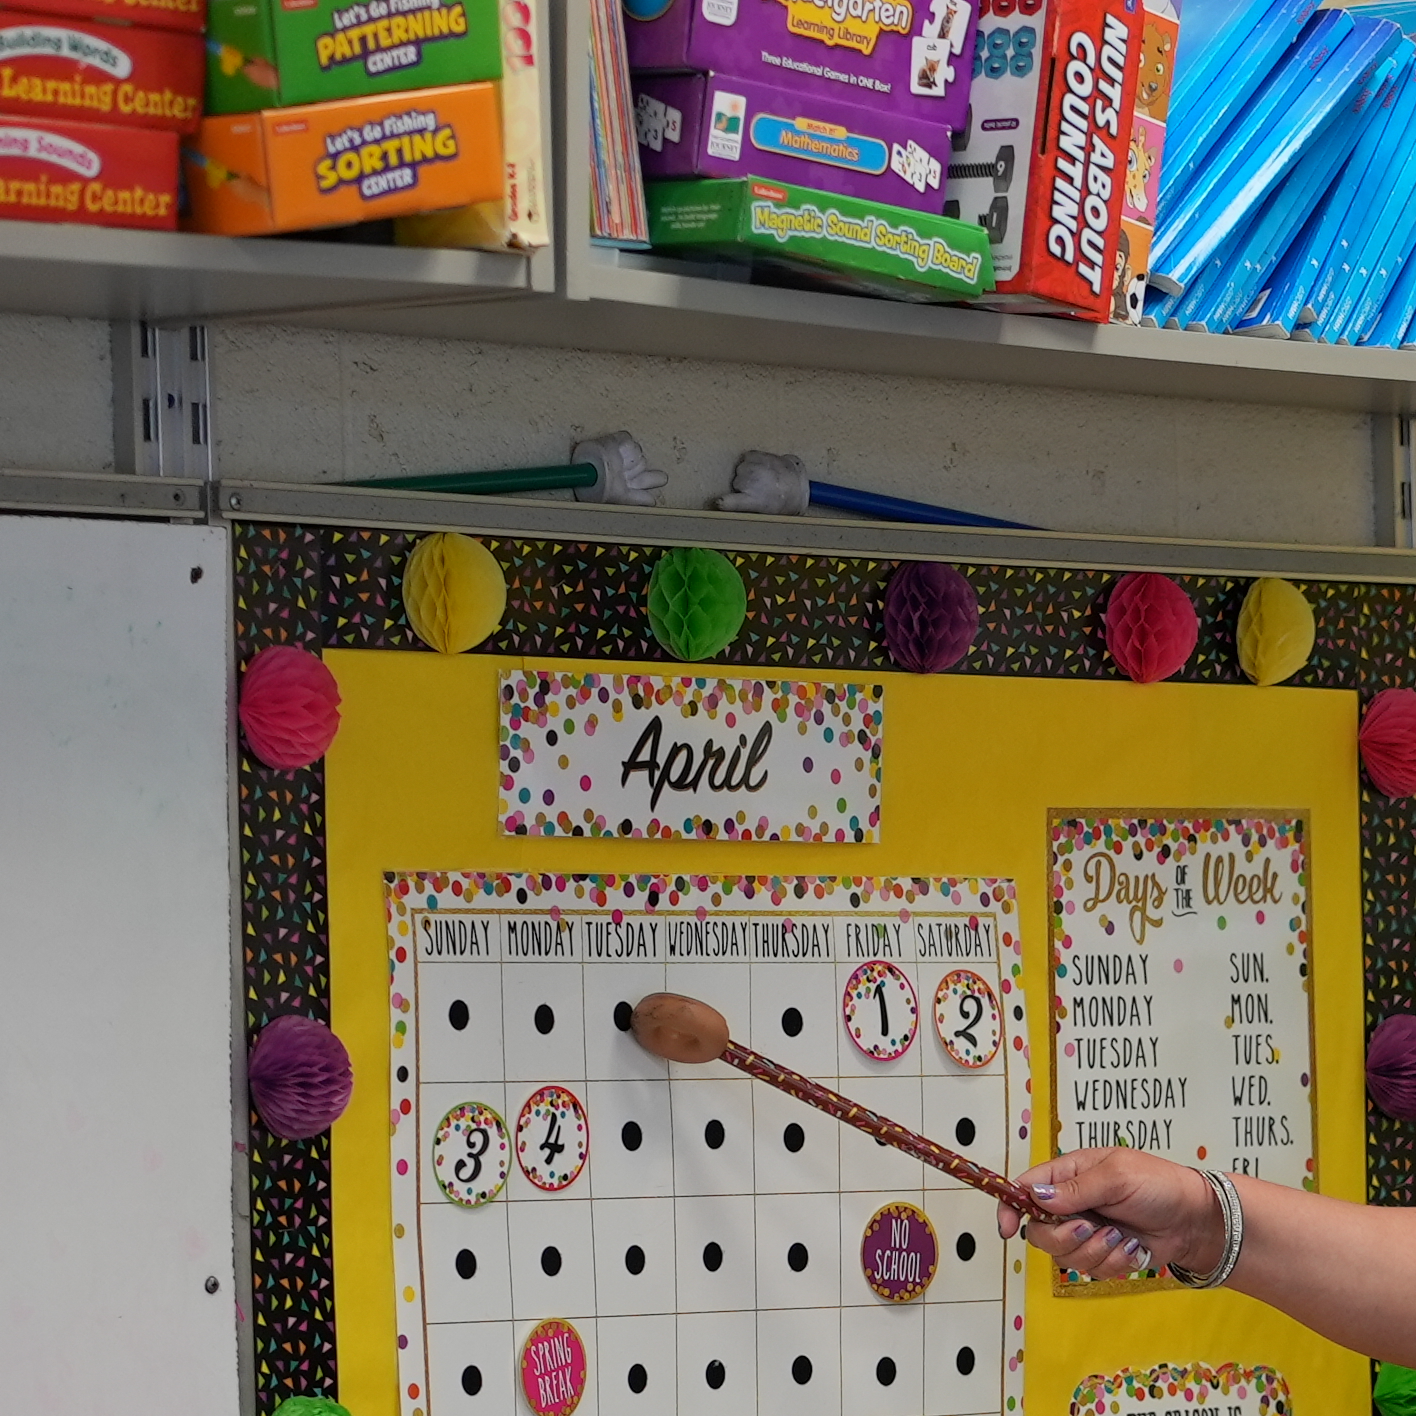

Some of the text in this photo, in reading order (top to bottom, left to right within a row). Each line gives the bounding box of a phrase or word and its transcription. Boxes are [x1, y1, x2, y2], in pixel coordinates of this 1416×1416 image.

[332, 3, 367, 29] Let's
[369, 0, 388, 18] Go
[316, 5, 468, 67] PATTERNING
[791, 15, 872, 50] Learning Library
[366, 45, 417, 74] CENTER
[761, 51, 781, 65] Three
[782, 57, 823, 76] Educational
[824, 68, 849, 83] Games
[1, 67, 197, 119] Learning Center
[326, 111, 436, 154] Let's Go Fishing
[780, 130, 860, 163] Mathematics
[1049, 31, 1095, 264] COUNTING
[316, 128, 457, 190] SORTING
[1077, 13, 1129, 294] NUTS ABOUT
[0, 174, 171, 216] arning Center
[362, 168, 414, 197] CENTER
[756, 209, 823, 237] Magnetic
[827, 214, 872, 242] Sound
[876, 227, 930, 265] Sorting
[933, 243, 978, 279] Board
[621, 715, 773, 813] April
[1175, 865, 1189, 886] OF
[1202, 852, 1283, 906] Week
[1083, 851, 1168, 945] Days
[1173, 888, 1193, 910] THE
[423, 919, 993, 959] SUNDAY MONDAY TUESDAY WEDNESDAY THURSDAY FRIDAY SATURDAY
[1072, 953, 1149, 986] SUNDAY
[1229, 952, 1269, 983] SUN.
[872, 983, 889, 1037] 1
[954, 994, 984, 1049] 2
[1072, 995, 1153, 1028] MONDAY
[1231, 993, 1273, 1025] MON.
[1074, 1036, 1159, 1069] TUESDAY
[1232, 1034, 1279, 1066] TUES.
[1074, 1077, 1188, 1111] WEDNESDAY
[1231, 1075, 1271, 1107] WED.
[539, 1111, 565, 1167] 4
[1075, 1118, 1173, 1150] THURSDAY
[1232, 1115, 1294, 1148] THURS.
[453, 1128, 490, 1184] 3
[891, 1218, 909, 1249] NO
[874, 1248, 921, 1283] SCHOOL
[530, 1332, 572, 1376] SPRING
[537, 1365, 575, 1408] BREAK
